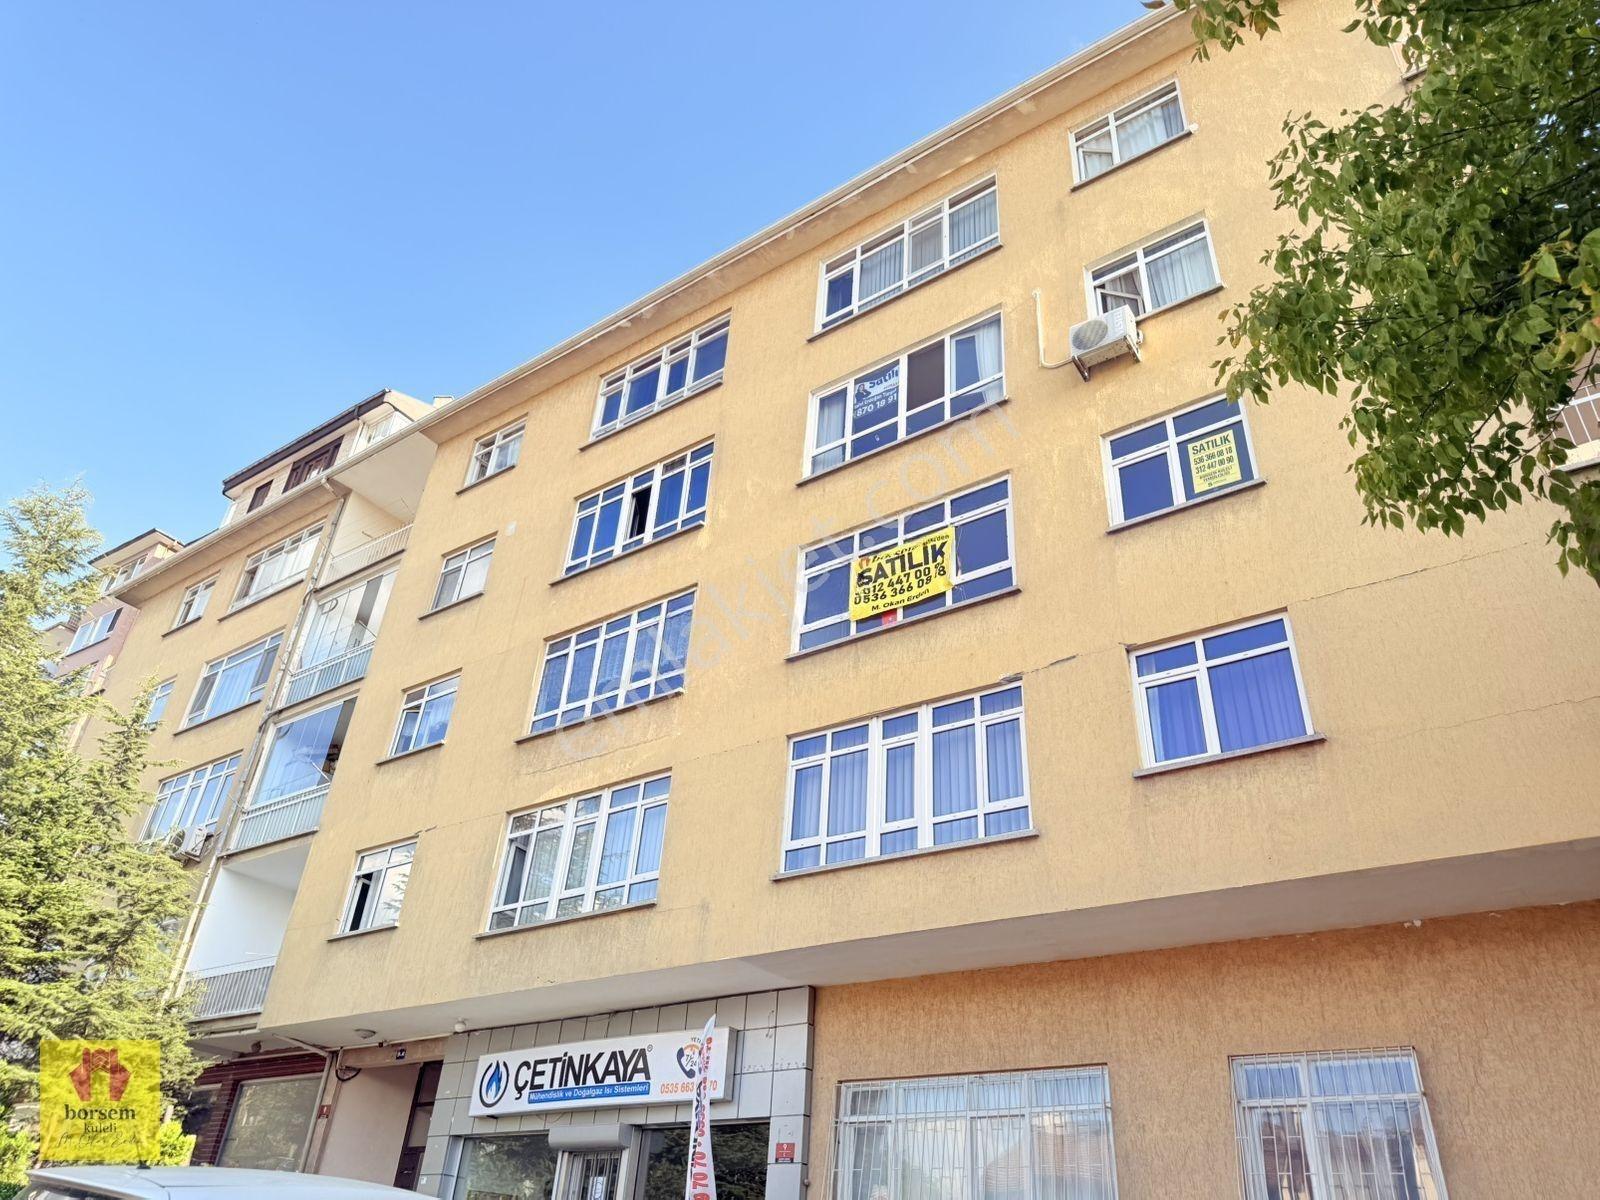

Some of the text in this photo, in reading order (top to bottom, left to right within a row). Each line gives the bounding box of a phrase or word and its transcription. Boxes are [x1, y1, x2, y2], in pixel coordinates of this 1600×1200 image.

[1192, 433, 1231, 455] SATILIK
[887, 572, 911, 588] 447
[914, 566, 931, 580] 00
[854, 590, 888, 605] 0536
[890, 581, 914, 598] 366
[916, 575, 932, 589] 08
[883, 599, 905, 608] Okan
[514, 1048, 652, 1100] ÇETİNKAYA
[573, 1087, 603, 1099] Doğalgaz
[614, 1083, 649, 1094] Sistemleri
[660, 1083, 680, 1095] 0535
[680, 1081, 695, 1094] 663
[692, 1172, 709, 1190] 70
